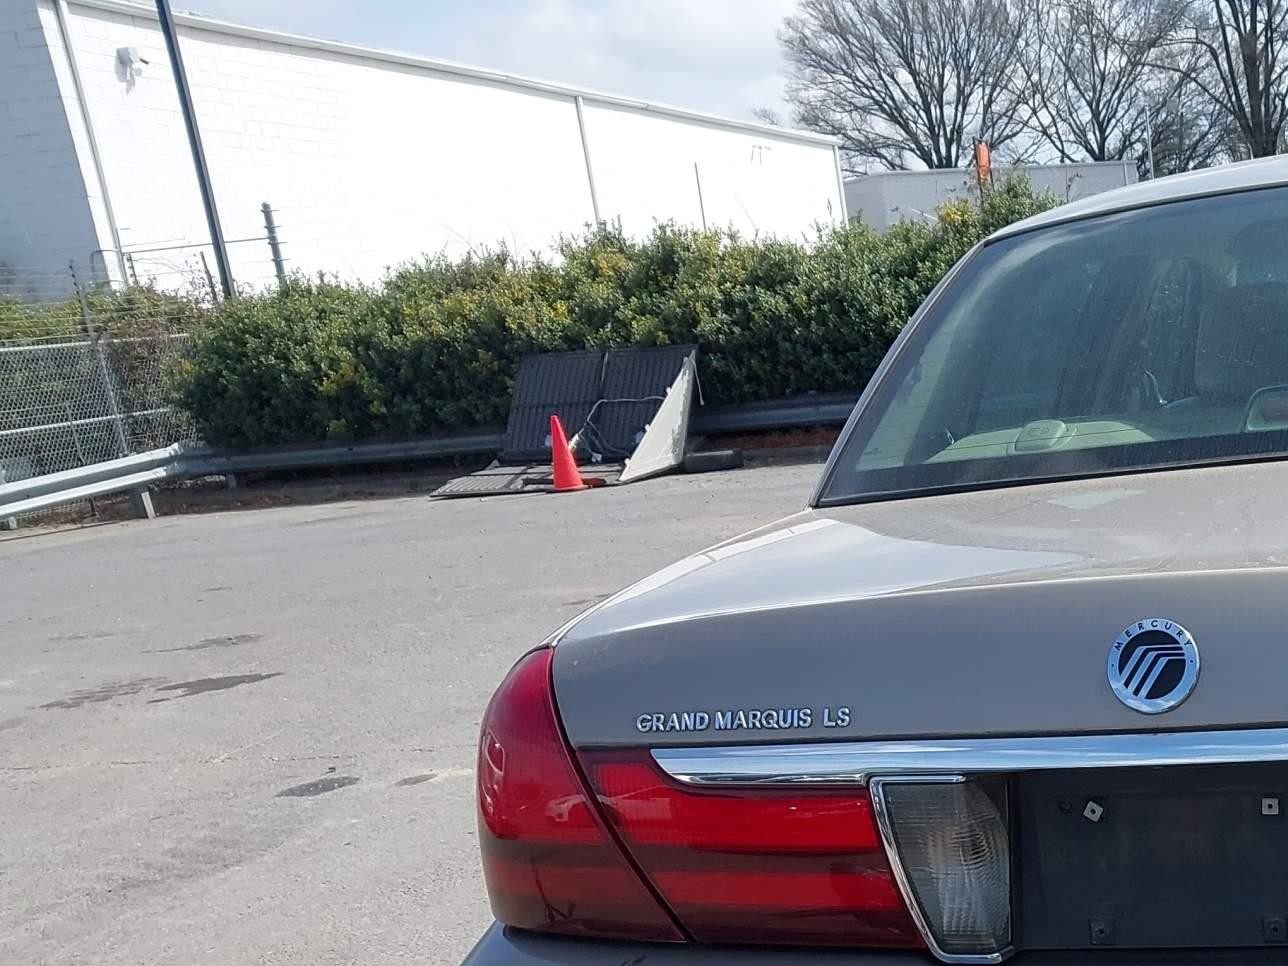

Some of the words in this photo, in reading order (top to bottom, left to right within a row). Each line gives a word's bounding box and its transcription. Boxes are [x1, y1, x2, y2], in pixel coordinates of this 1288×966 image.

[1114, 619, 1192, 651] MERCURY
[636, 713, 709, 732] GRAND
[714, 708, 812, 730] MARQUIS
[822, 707, 850, 728] LS
